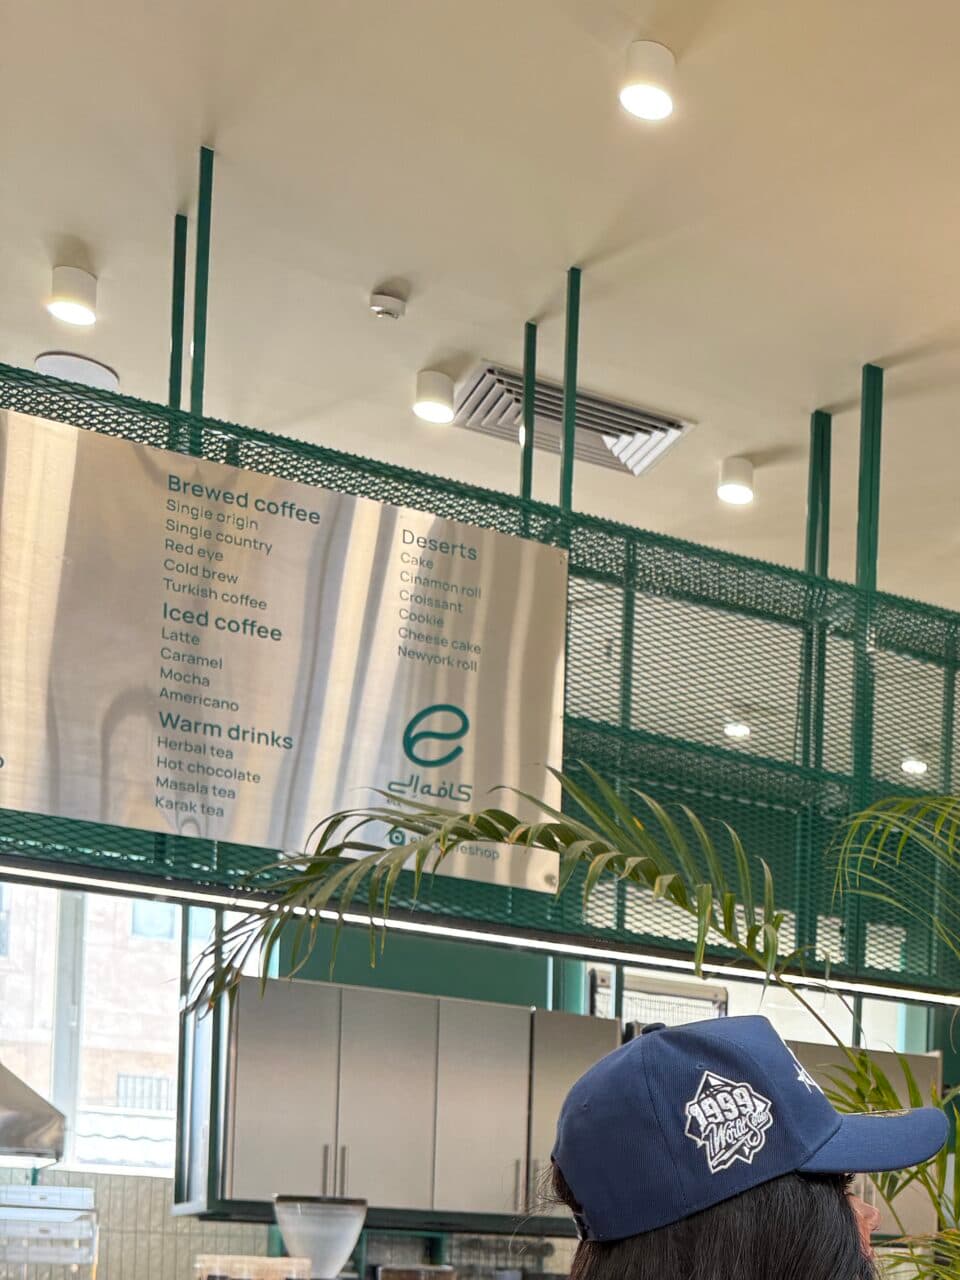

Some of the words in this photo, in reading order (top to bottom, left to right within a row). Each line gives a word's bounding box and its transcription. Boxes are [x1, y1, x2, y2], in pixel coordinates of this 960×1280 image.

[168, 474, 249, 508] Brewed
[254, 498, 321, 525] coffee
[166, 499, 213, 520] Single
[216, 512, 259, 530] origin
[165, 518, 212, 540] Single
[215, 532, 273, 555] country
[165, 539, 194, 556] Red
[197, 548, 224, 562] eye
[402, 529, 478, 561] Deserts
[163, 558, 199, 577] Cold
[202, 568, 239, 584] brew
[400, 552, 434, 570] Cake
[163, 577, 218, 600] Turkish
[221, 592, 268, 610] coffee
[400, 570, 459, 593] Cinamon
[461, 586, 482, 599] roll
[399, 589, 464, 613] Croissant
[163, 602, 209, 627] Iced
[214, 616, 282, 642] coffee
[399, 608, 445, 628] Cookie
[161, 627, 200, 646] Latte
[398, 626, 449, 648] Cheese
[451, 639, 482, 655] cake
[160, 647, 223, 670] Caramel
[397, 645, 454, 667] Newyork
[457, 659, 478, 673] roll
[160, 666, 210, 688] Mocha
[159, 687, 240, 712] Americano
[159, 711, 222, 738] Warm
[227, 724, 294, 750] drinks
[157, 735, 206, 752] Herbal
[210, 745, 234, 760] tea
[157, 756, 183, 770] Hot
[187, 763, 262, 784] chocolate
[155, 775, 209, 795] Masala
[212, 785, 236, 799] tea
[154, 795, 197, 814] Karak
[201, 804, 225, 818] tea
[688, 1086, 756, 1132] 1999
[702, 1116, 750, 1157] World
